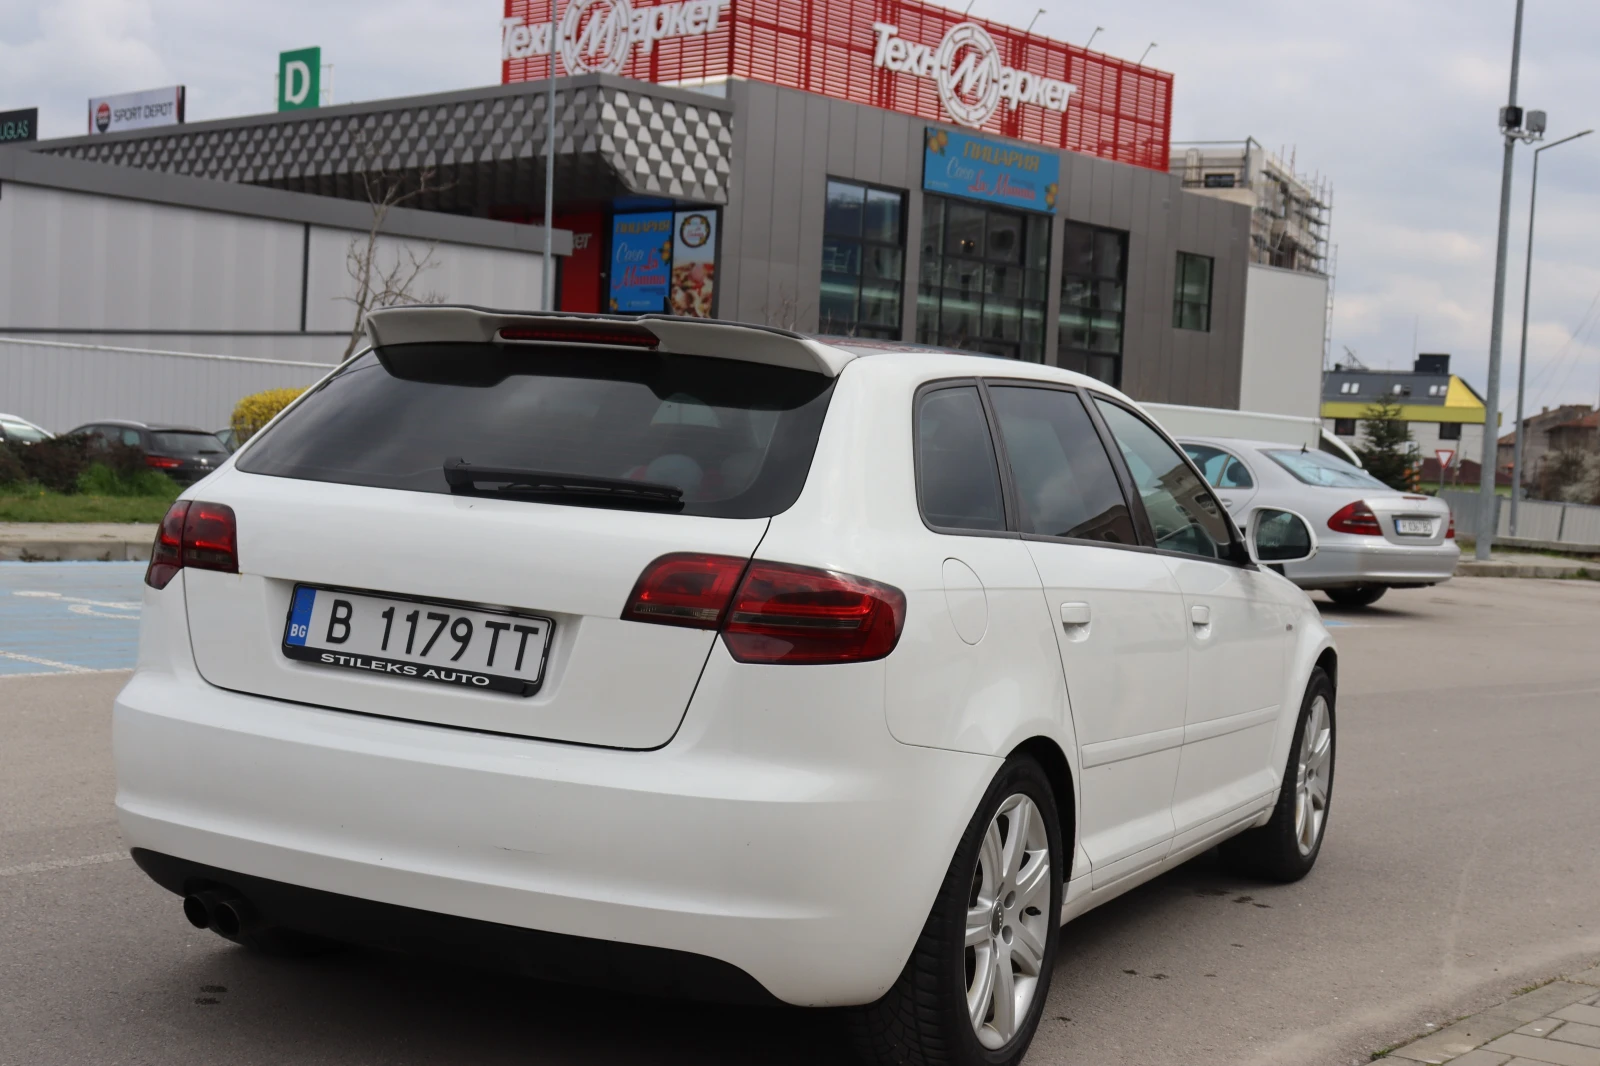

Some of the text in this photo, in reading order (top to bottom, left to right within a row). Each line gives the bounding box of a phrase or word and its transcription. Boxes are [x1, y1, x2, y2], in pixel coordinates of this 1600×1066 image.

[284, 60, 311, 105] D
[114, 106, 142, 123] SPORT
[143, 101, 174, 119] DEPOT
[290, 623, 307, 638] BG
[325, 599, 540, 671] B 1179 TT
[320, 653, 490, 687] STILEKS AUTO
